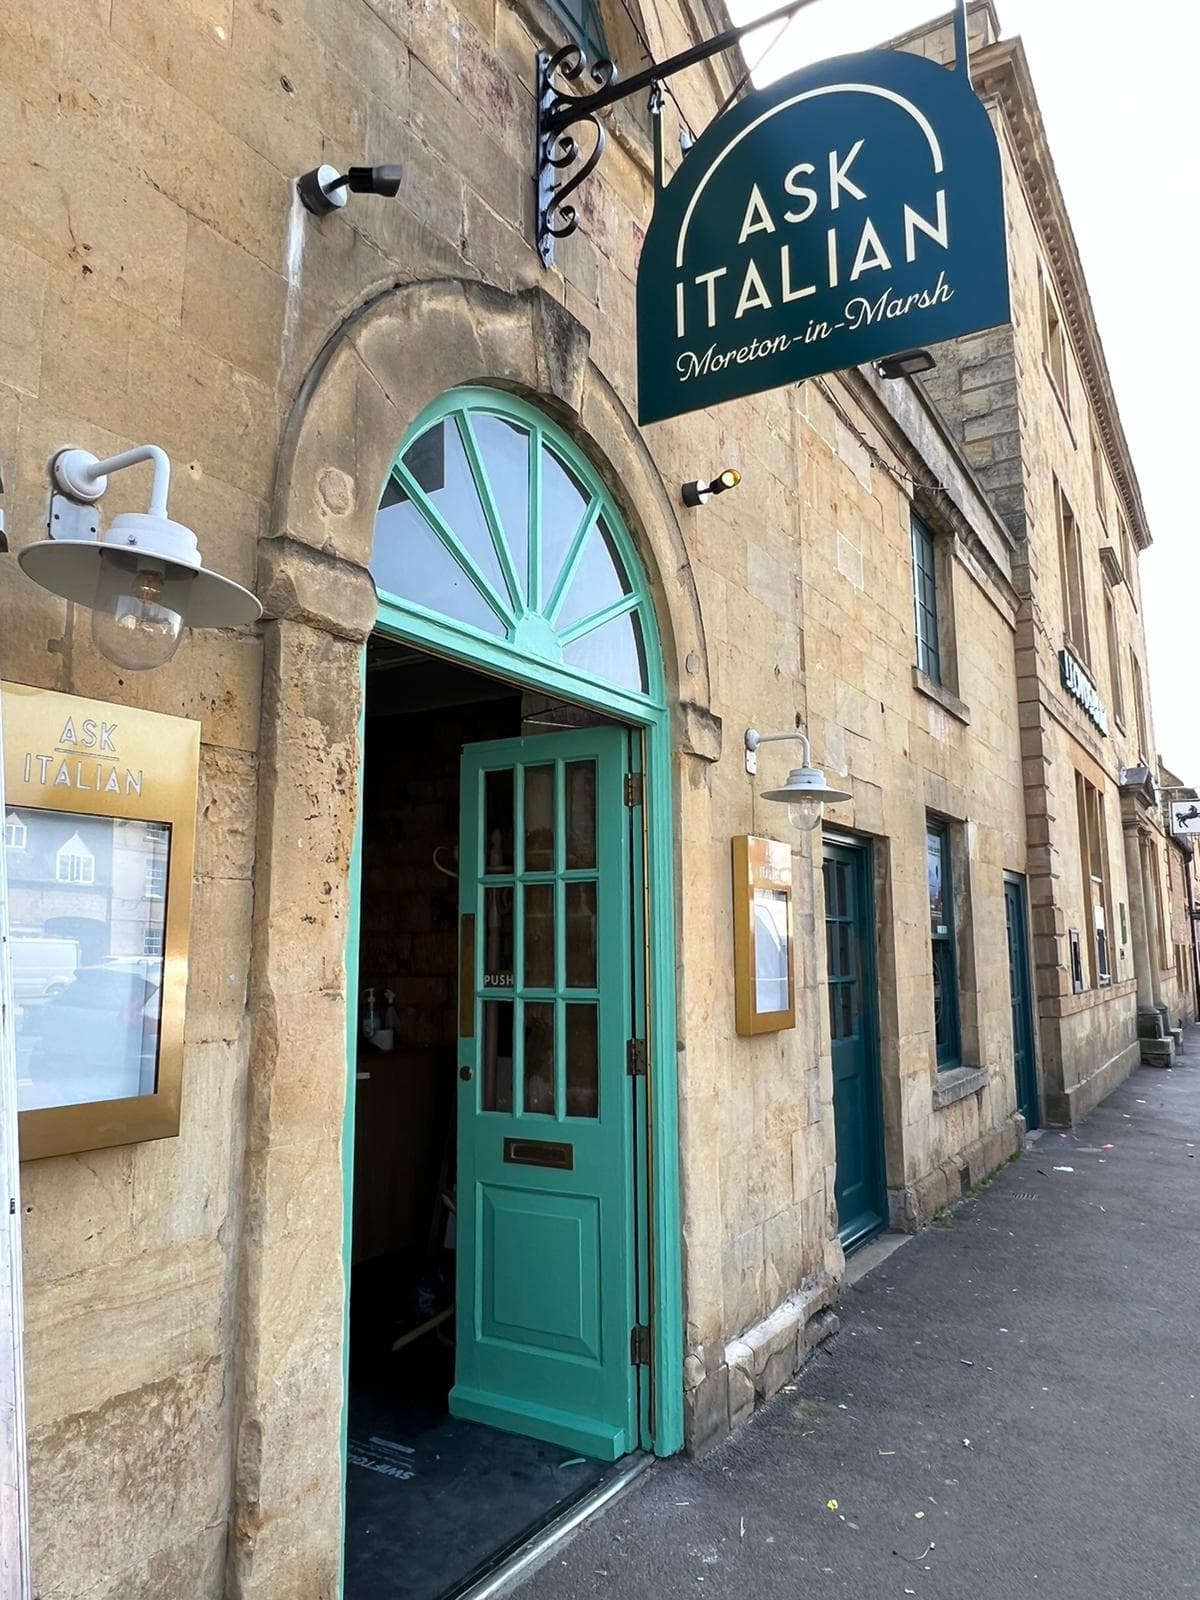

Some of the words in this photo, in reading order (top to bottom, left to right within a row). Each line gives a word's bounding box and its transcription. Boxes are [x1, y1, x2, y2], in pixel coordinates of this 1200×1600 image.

[738, 138, 867, 245] ASK
[676, 189, 948, 338] ITALIAN
[676, 270, 955, 382] Moreton-in-Marsh
[59, 715, 118, 752] ASK
[23, 752, 143, 798] ITALIAN
[484, 974, 514, 986] PUSH
